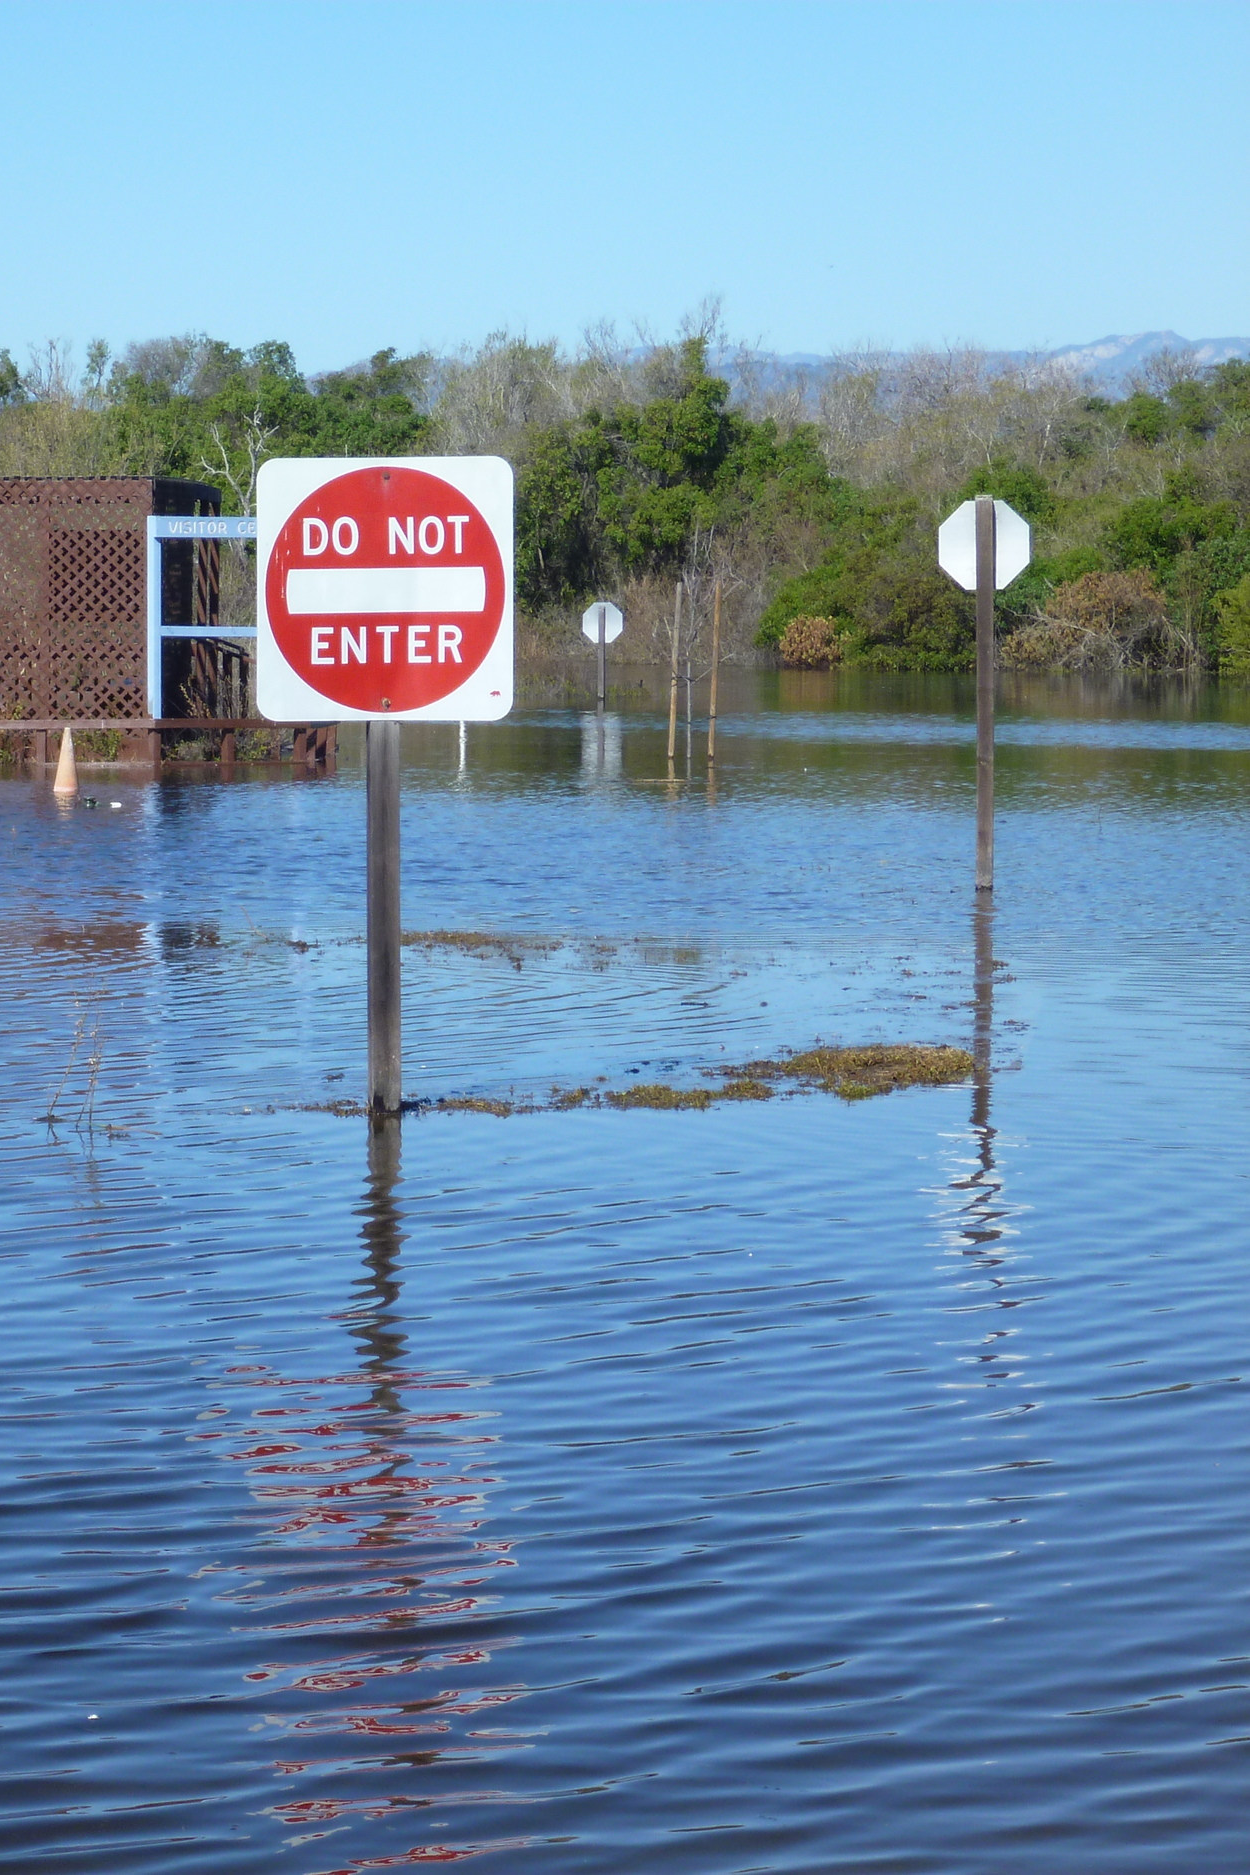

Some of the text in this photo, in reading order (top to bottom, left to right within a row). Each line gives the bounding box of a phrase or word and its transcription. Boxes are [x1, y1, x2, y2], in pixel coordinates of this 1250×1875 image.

[168, 521, 227, 534] VISITOR
[302, 515, 470, 556] DO NOT
[311, 624, 463, 665] ENTER
